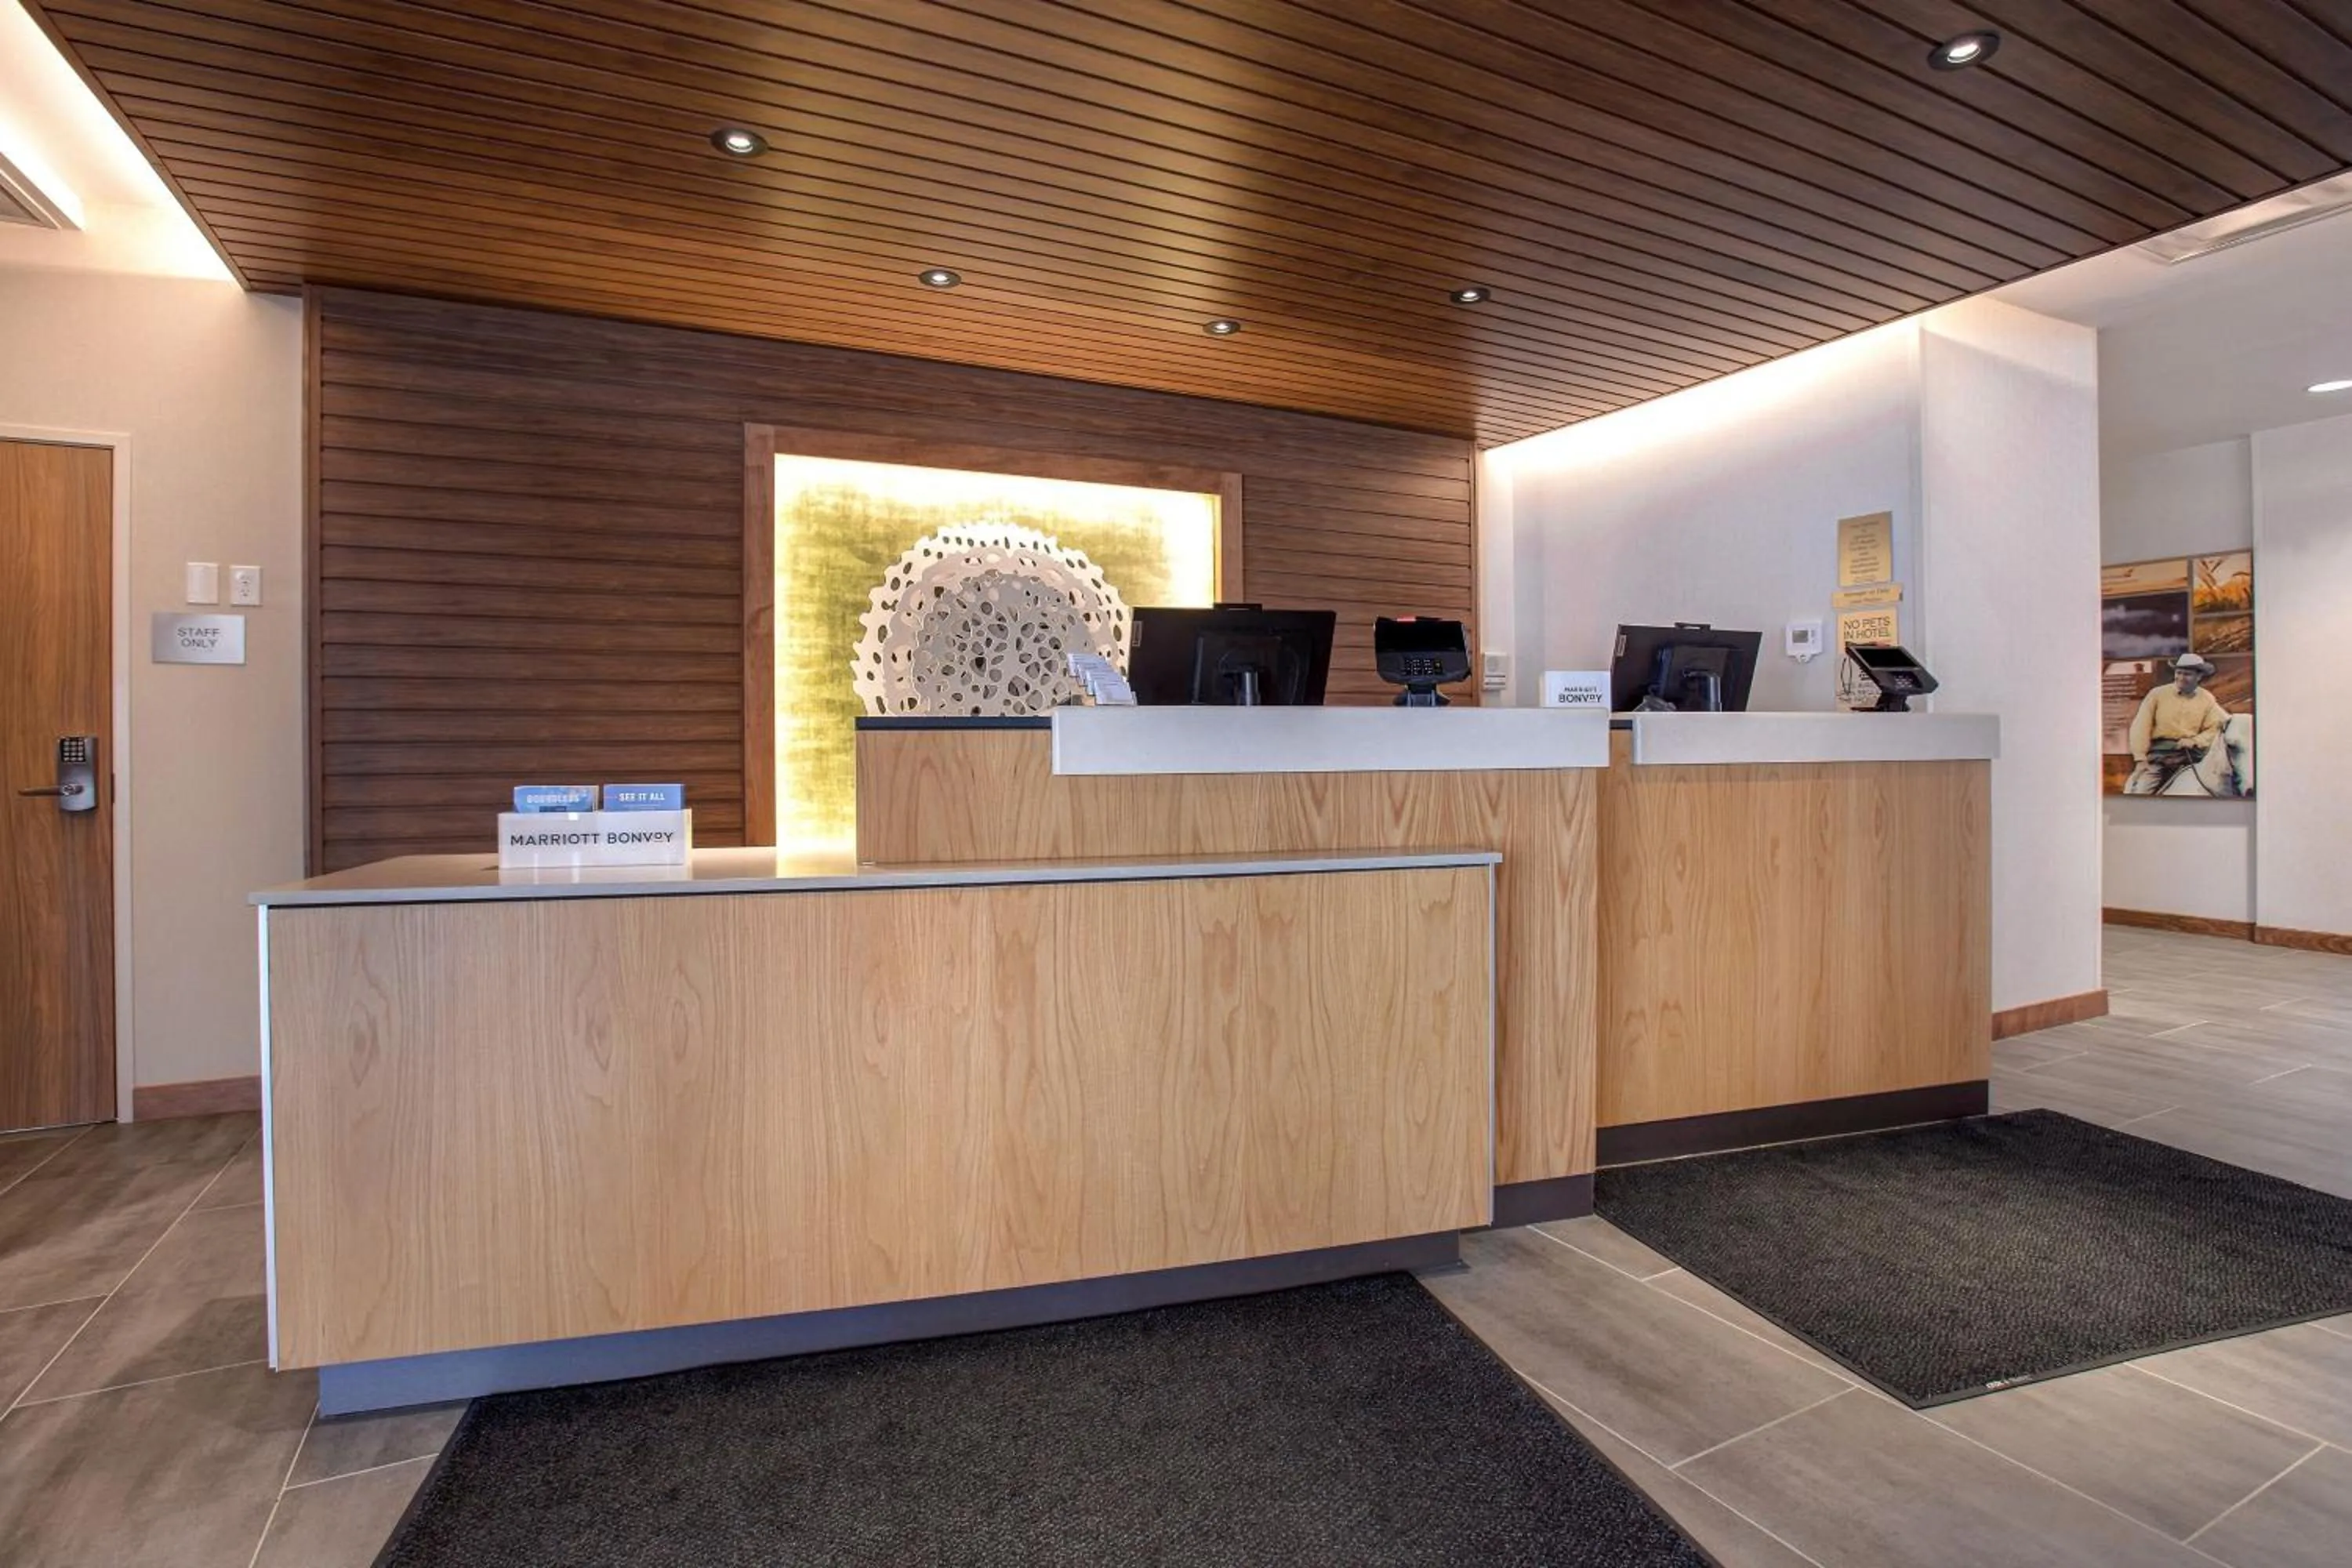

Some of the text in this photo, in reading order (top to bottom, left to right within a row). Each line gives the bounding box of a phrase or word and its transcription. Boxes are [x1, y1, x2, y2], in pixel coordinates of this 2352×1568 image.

[1843, 615, 1891, 630] NO PETS
[176, 627, 221, 637] STAFF
[1843, 626, 1891, 640] IN HOTEL
[180, 637, 218, 648] ONLY
[619, 792, 666, 802] SEE IT ALL
[510, 831, 674, 847] MARRIOTT BONVOY
